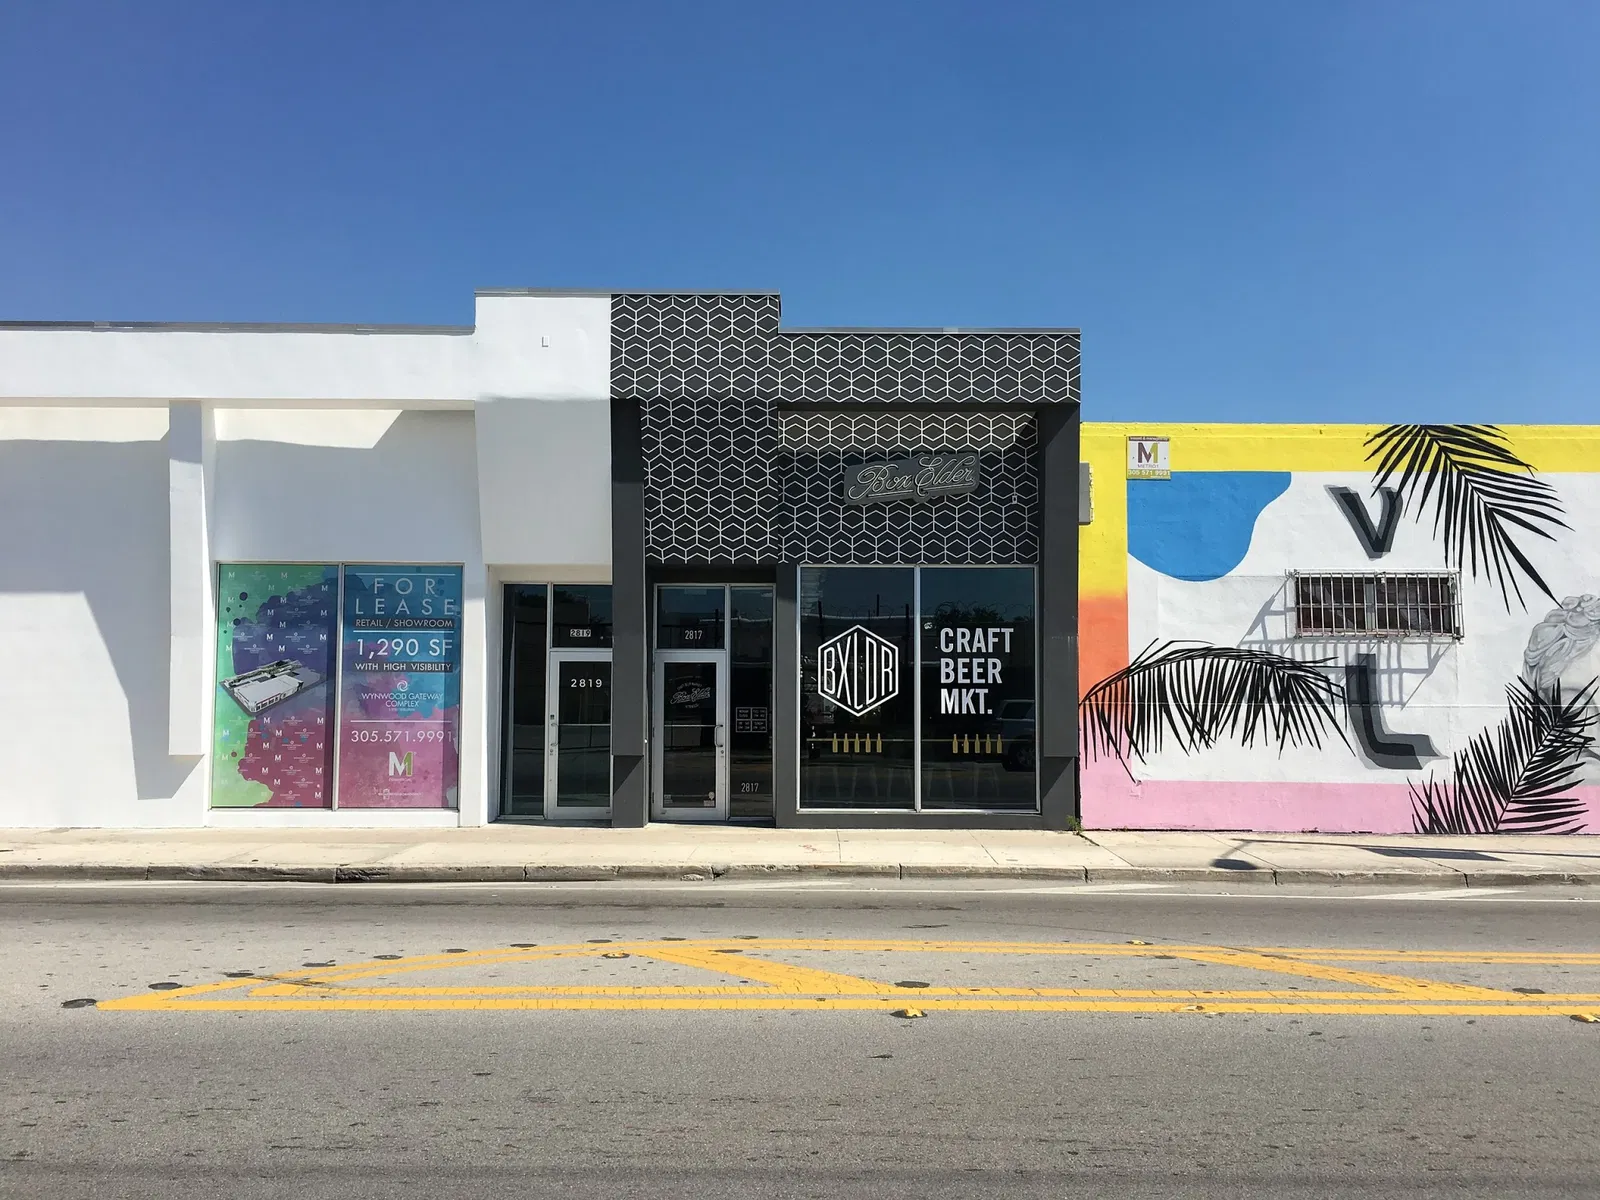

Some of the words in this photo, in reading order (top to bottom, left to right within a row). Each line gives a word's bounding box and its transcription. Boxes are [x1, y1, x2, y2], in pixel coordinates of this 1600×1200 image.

[848, 464, 912, 500] Box
[914, 455, 976, 496] Elder
[374, 577, 436, 595] FOR
[355, 598, 454, 615] LEASE
[355, 619, 383, 627] RETAIL
[385, 618, 391, 628] /
[394, 619, 453, 627] SHOWROOM
[570, 628, 591, 637] 2819
[684, 630, 703, 640] 2817
[940, 627, 1014, 653] CRAFT
[357, 638, 419, 659] 1,290
[429, 638, 453, 656] SF
[355, 662, 379, 671] WITH
[383, 662, 406, 671] HIGH
[411, 663, 452, 671] VISIBILITY
[940, 658, 1003, 684] BEER
[570, 678, 602, 688] 2819
[361, 692, 407, 700] WYNWOOD
[408, 692, 444, 700] GATEWAY
[940, 688, 993, 714] MKT.
[351, 730, 452, 743] 305.571.9991
[741, 782, 759, 793] 2817
